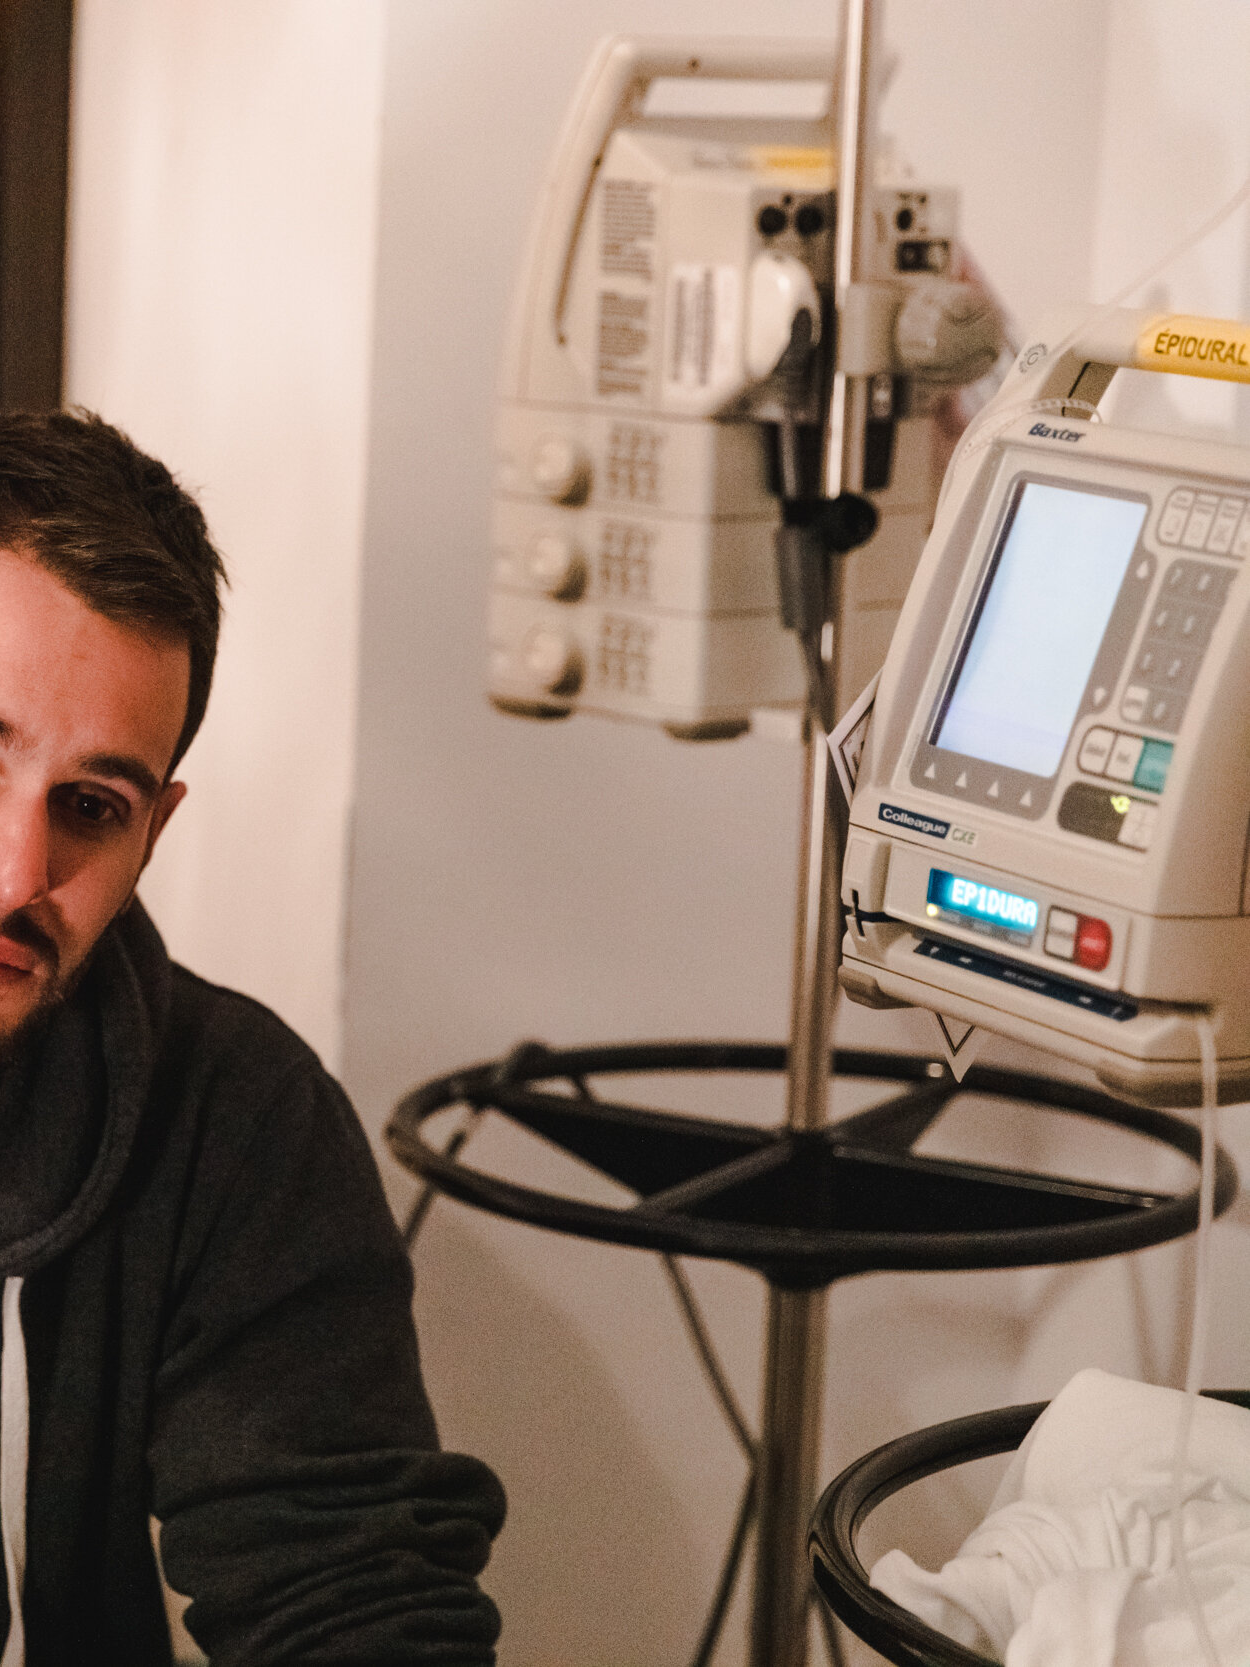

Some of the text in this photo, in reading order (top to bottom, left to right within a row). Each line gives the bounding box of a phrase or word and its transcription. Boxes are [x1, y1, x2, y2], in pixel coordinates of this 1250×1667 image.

[1154, 328, 1248, 366] ÉPIDURAL
[1028, 423, 1087, 442] Baxter
[882, 807, 977, 845] Colleague CXE
